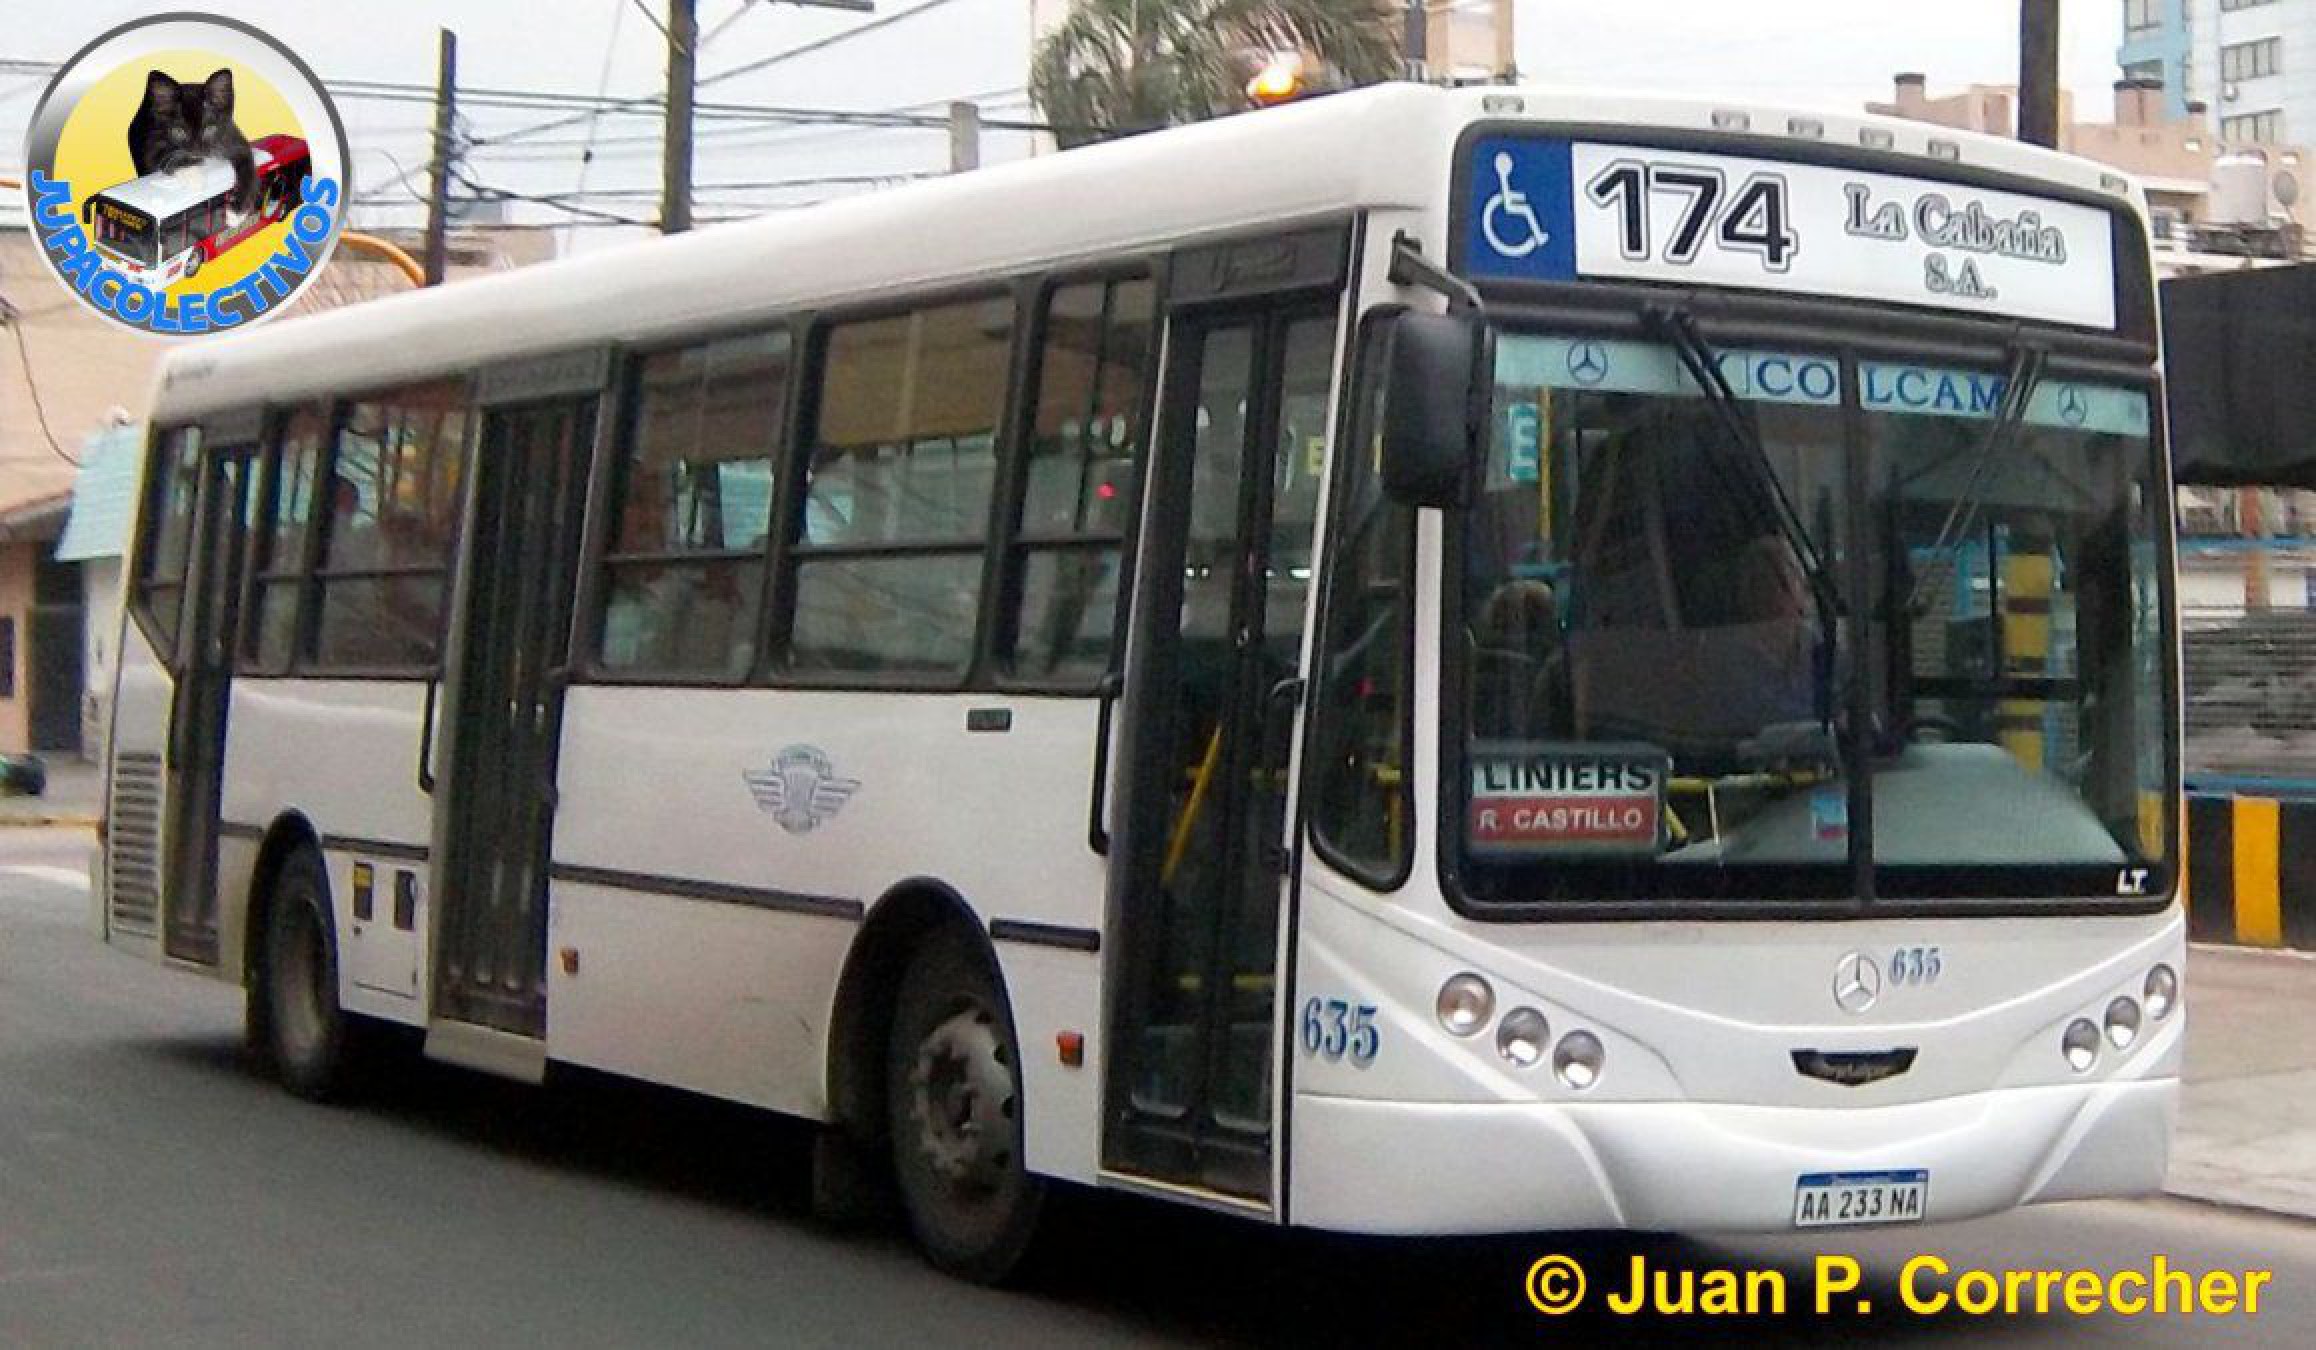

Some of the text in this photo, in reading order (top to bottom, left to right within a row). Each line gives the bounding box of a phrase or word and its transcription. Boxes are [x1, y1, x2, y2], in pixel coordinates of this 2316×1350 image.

[1585, 158, 1799, 274] 174
[1844, 182, 2067, 265] La Cabaña
[1923, 252, 1998, 298] S.A.
[1484, 763, 1653, 792] LINIERS
[1514, 806, 1642, 832] CASTILLO
[1890, 947, 1941, 985] 635
[1303, 996, 1379, 1071] 635
[1801, 1187, 1918, 1220] AA 233 NA
